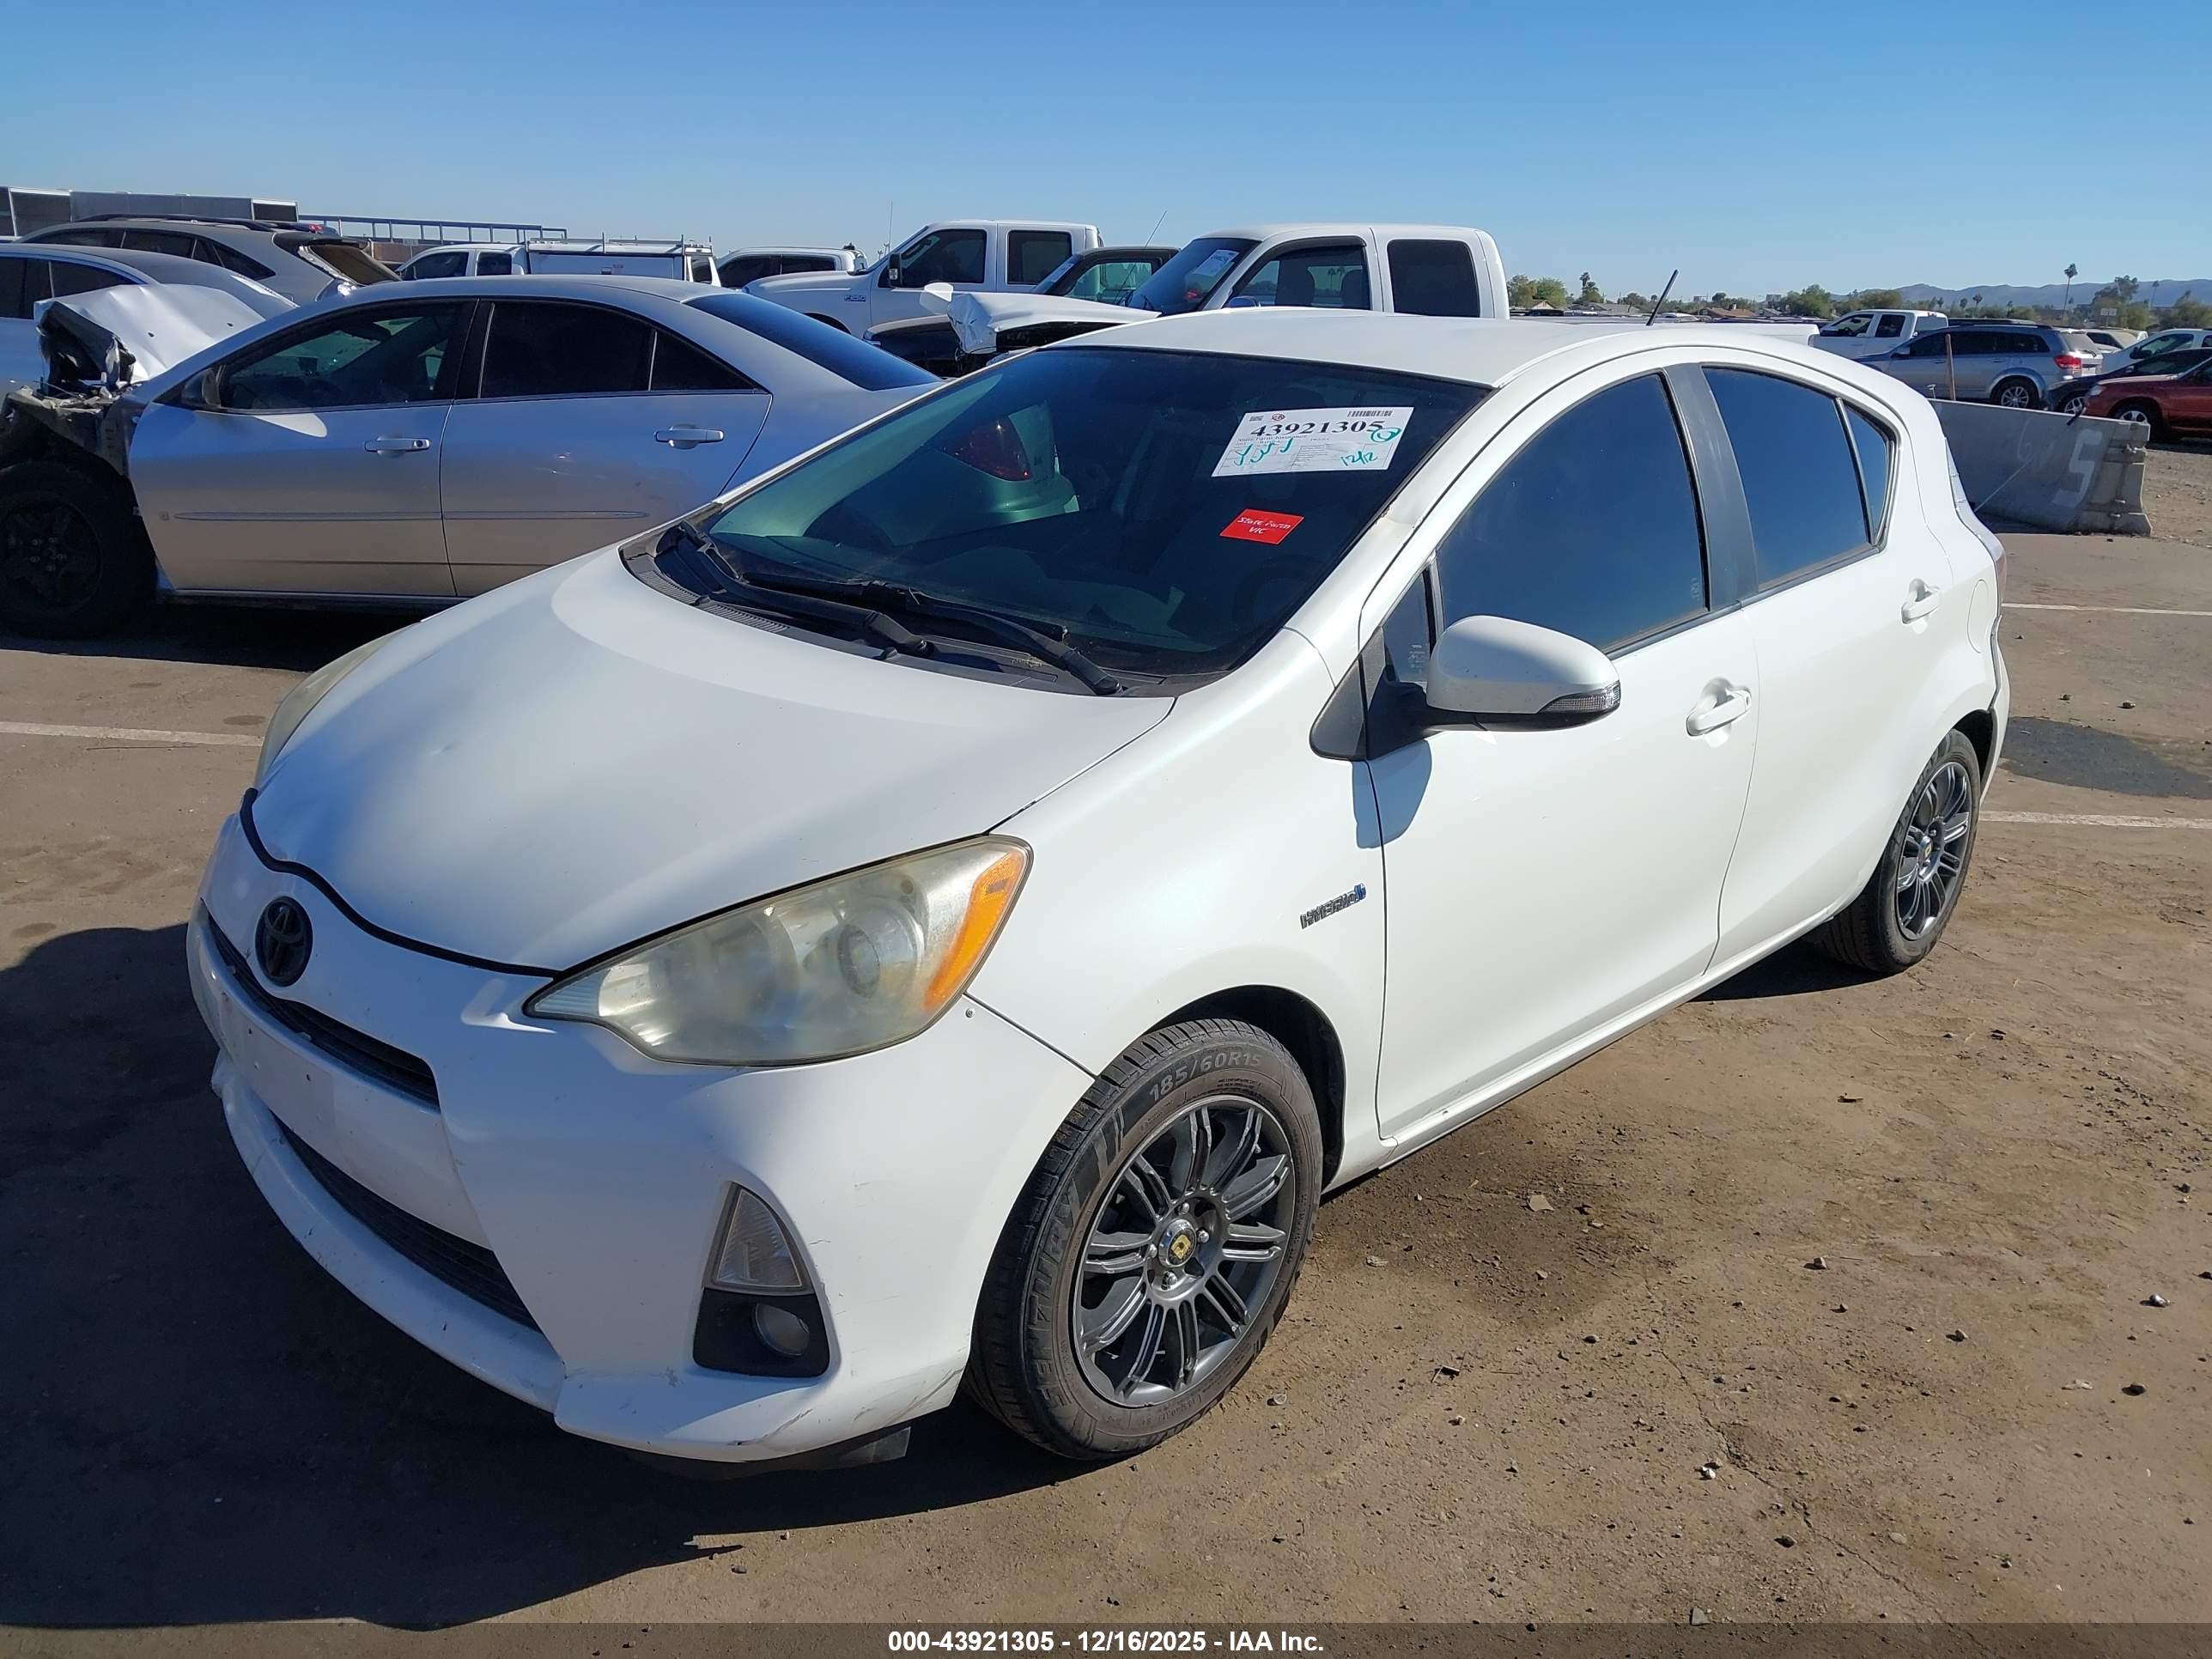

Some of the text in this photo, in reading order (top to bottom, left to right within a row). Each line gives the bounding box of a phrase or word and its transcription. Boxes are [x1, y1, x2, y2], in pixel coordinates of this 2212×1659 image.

[1250, 420, 1386, 437] 43921305
[2054, 429, 2103, 508] 5
[1150, 1052, 1262, 1102] 185/60R15
